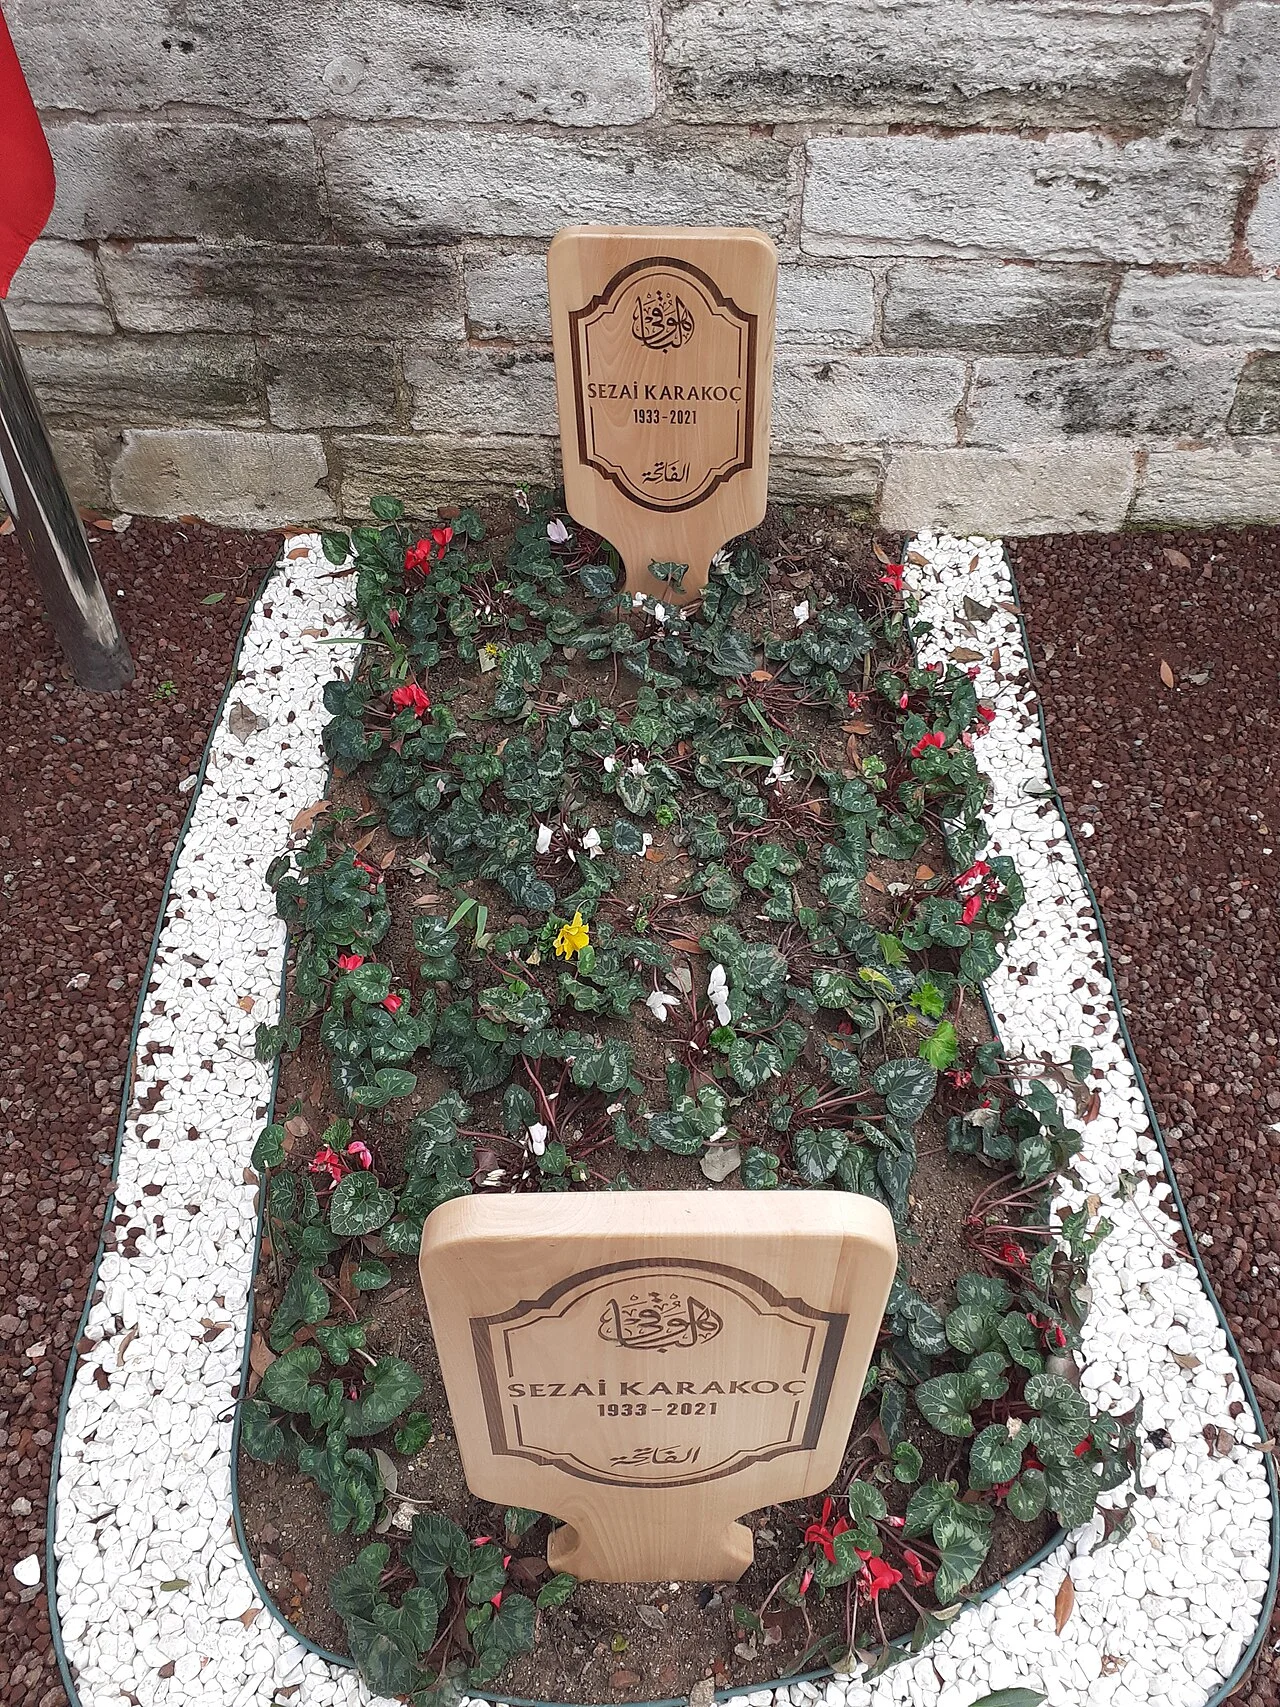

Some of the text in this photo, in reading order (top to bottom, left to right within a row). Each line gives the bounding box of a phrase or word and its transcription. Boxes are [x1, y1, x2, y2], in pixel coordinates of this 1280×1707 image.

[587, 381, 742, 404] SEZAİ KARAKOÇ
[633, 409, 697, 424] 1933-2021
[508, 1379, 807, 1398] SEZAİ KARAKOÇ
[597, 1402, 717, 1417] 1933-2021
